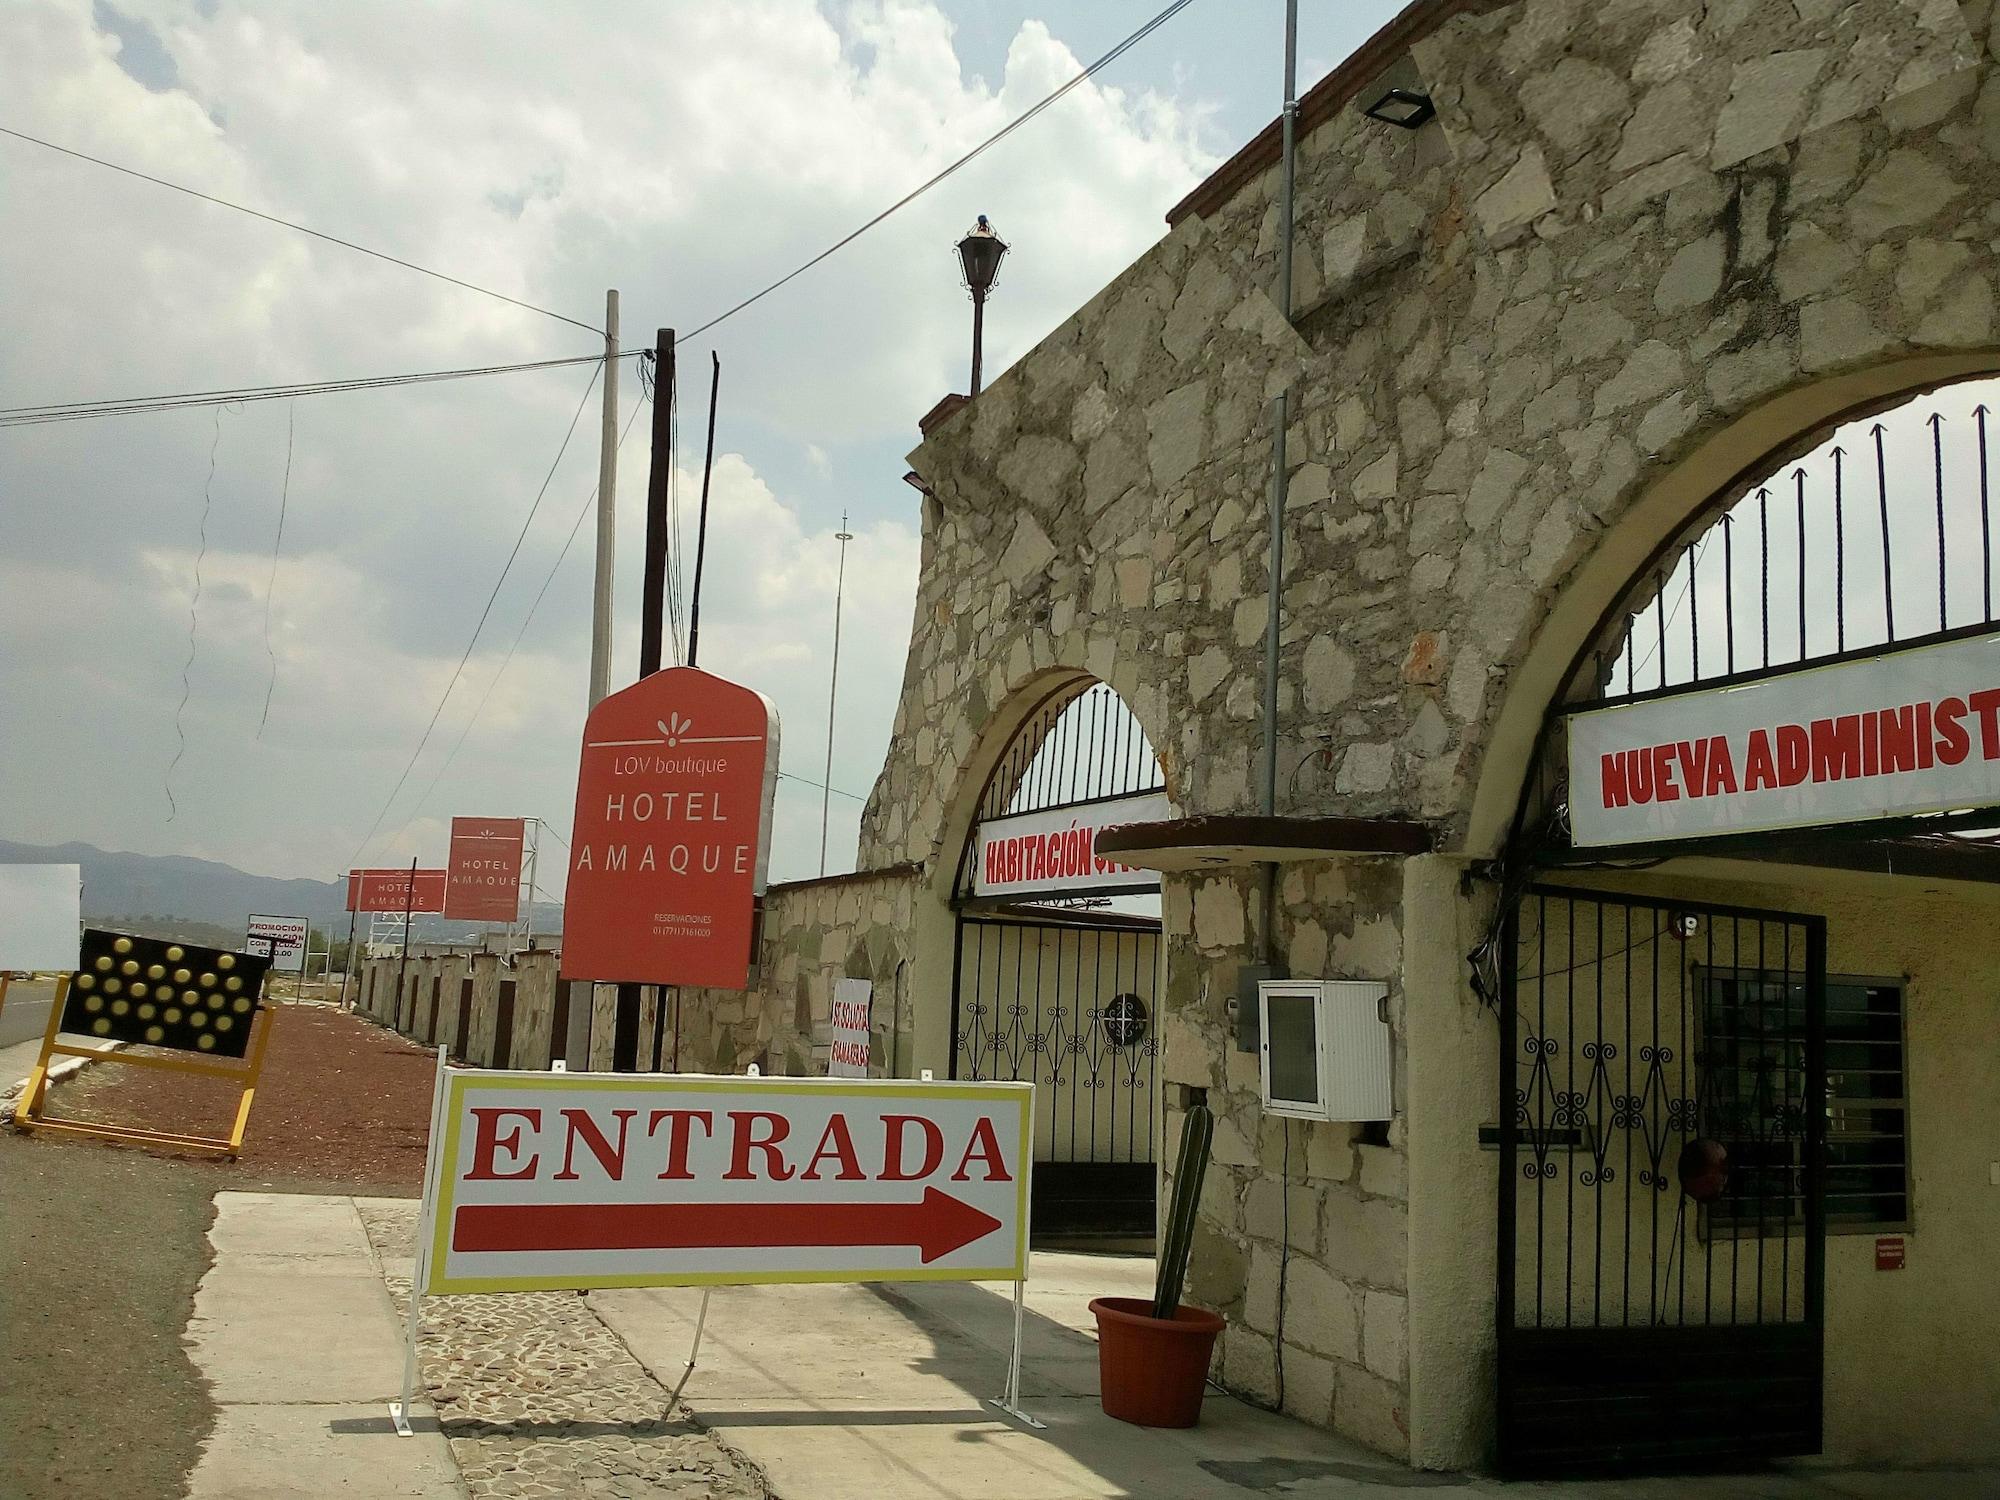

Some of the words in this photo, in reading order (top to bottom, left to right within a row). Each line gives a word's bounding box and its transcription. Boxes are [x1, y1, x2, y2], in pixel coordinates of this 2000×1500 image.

[614, 756, 651, 775] LOV
[655, 756, 728, 777] boutique
[1600, 735, 1738, 809] NUEVA
[606, 792, 728, 822] HOTEL
[576, 844, 749, 875] AMAQUE
[985, 819, 1093, 885] HABITACIÓN
[462, 860, 510, 870] HOTEL
[378, 883, 418, 893] HOTEL
[452, 875, 518, 887] AMAQUE
[654, 913, 712, 924] RESERVACIONES
[462, 1107, 1014, 1182] ENTRADA
